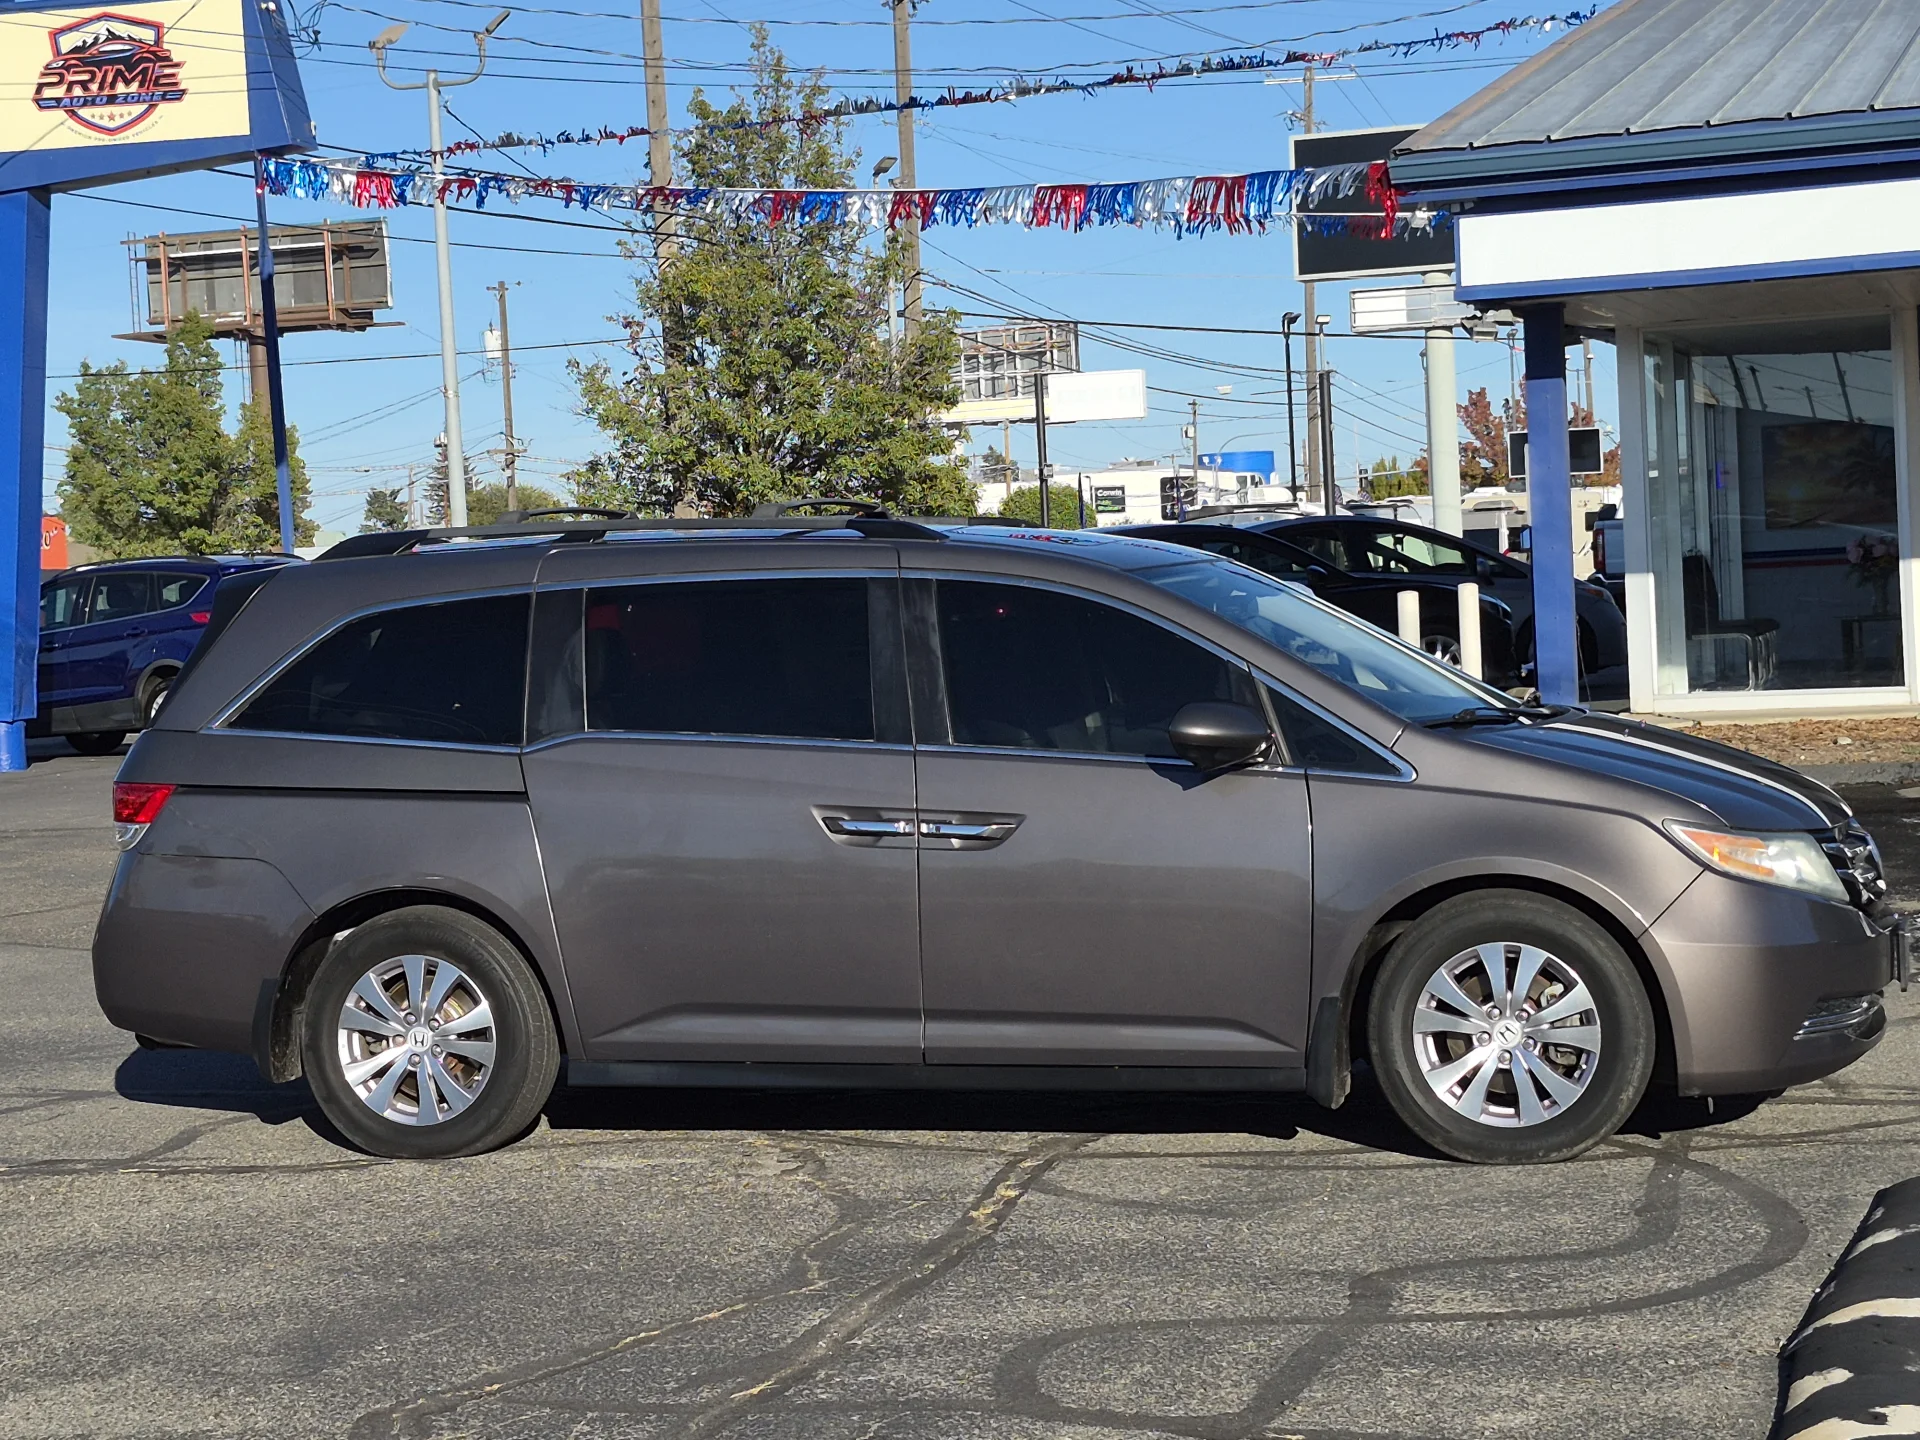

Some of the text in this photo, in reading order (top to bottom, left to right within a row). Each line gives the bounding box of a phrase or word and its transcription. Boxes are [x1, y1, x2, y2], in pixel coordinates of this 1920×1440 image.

[34, 61, 187, 98] PRIME
[60, 91, 164, 107] AUTO ZONE
